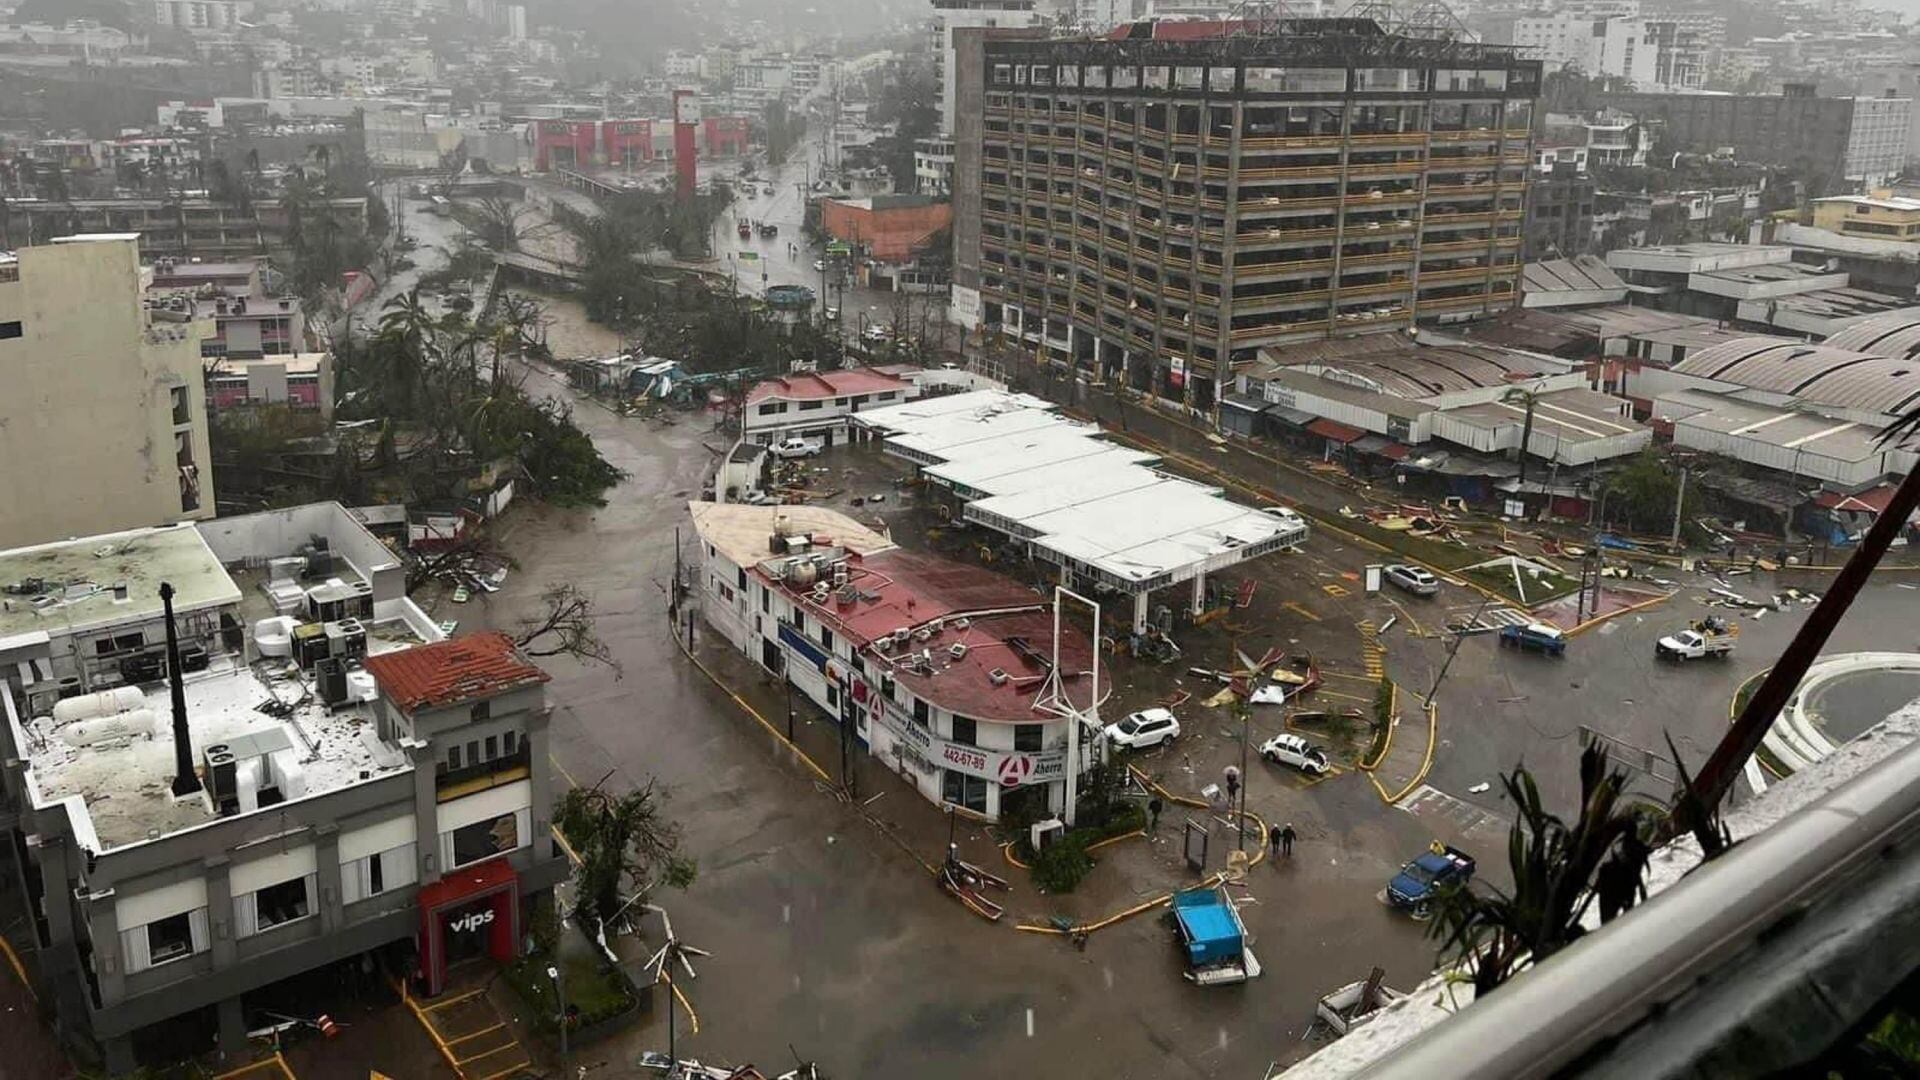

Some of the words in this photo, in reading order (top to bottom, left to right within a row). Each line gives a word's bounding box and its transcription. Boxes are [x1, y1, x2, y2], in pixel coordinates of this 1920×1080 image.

[905, 720, 931, 748] Ahorro
[943, 748, 985, 770] 442-67-89
[1033, 762, 1063, 776] Ahorro
[450, 909, 495, 932] vips
